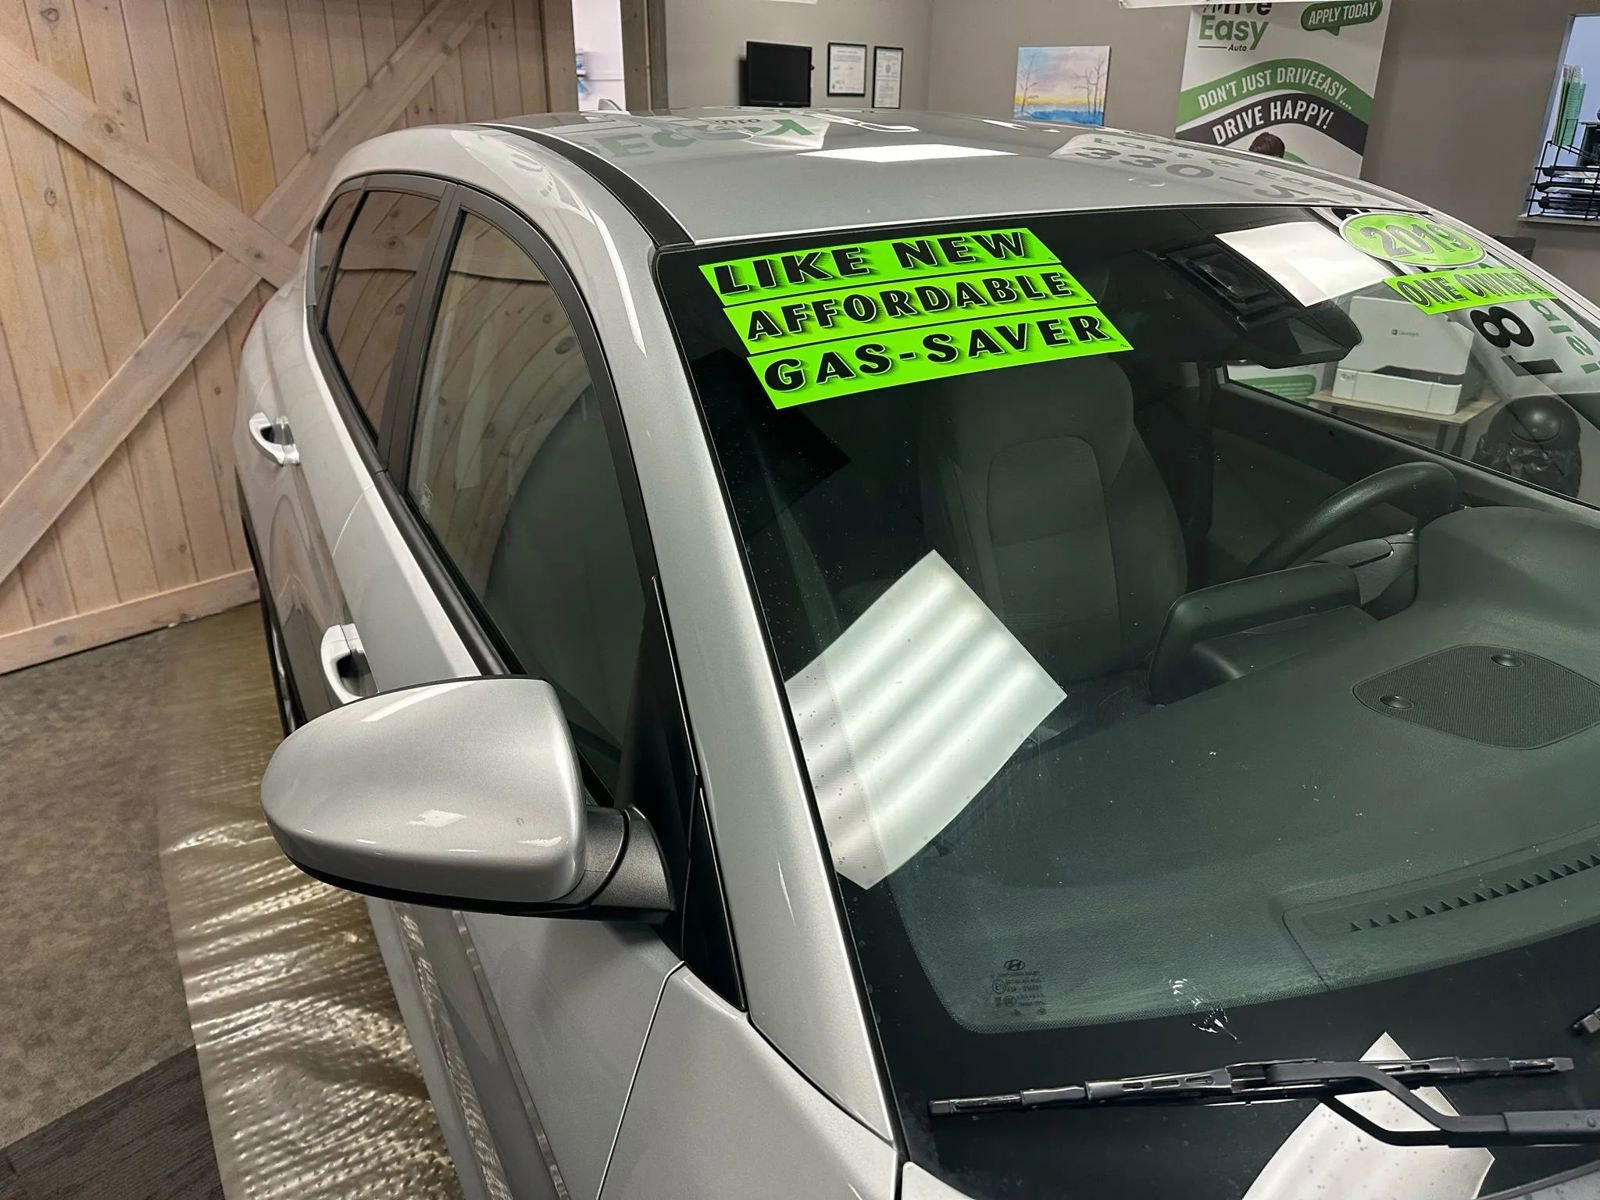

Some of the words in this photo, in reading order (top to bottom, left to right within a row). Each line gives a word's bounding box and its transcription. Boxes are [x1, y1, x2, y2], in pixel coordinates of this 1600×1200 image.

[1199, 15, 1269, 50] Easy
[1308, 7, 1341, 25] APPLY
[1343, 2, 1377, 20] TODAY
[1228, 44, 1248, 52] Auto
[1197, 81, 1237, 111] DON'T
[1241, 70, 1272, 95] JUST
[1212, 105, 1265, 145] DRIVE
[1270, 99, 1335, 130] HAPPY!
[1360, 223, 1473, 259] 2019
[714, 247, 871, 297] LIKE
[891, 230, 1027, 270] NEW
[747, 271, 1073, 342] AFFORDABLE
[1396, 277, 1468, 307] ONE
[763, 315, 1111, 394] GAS-SAVER
